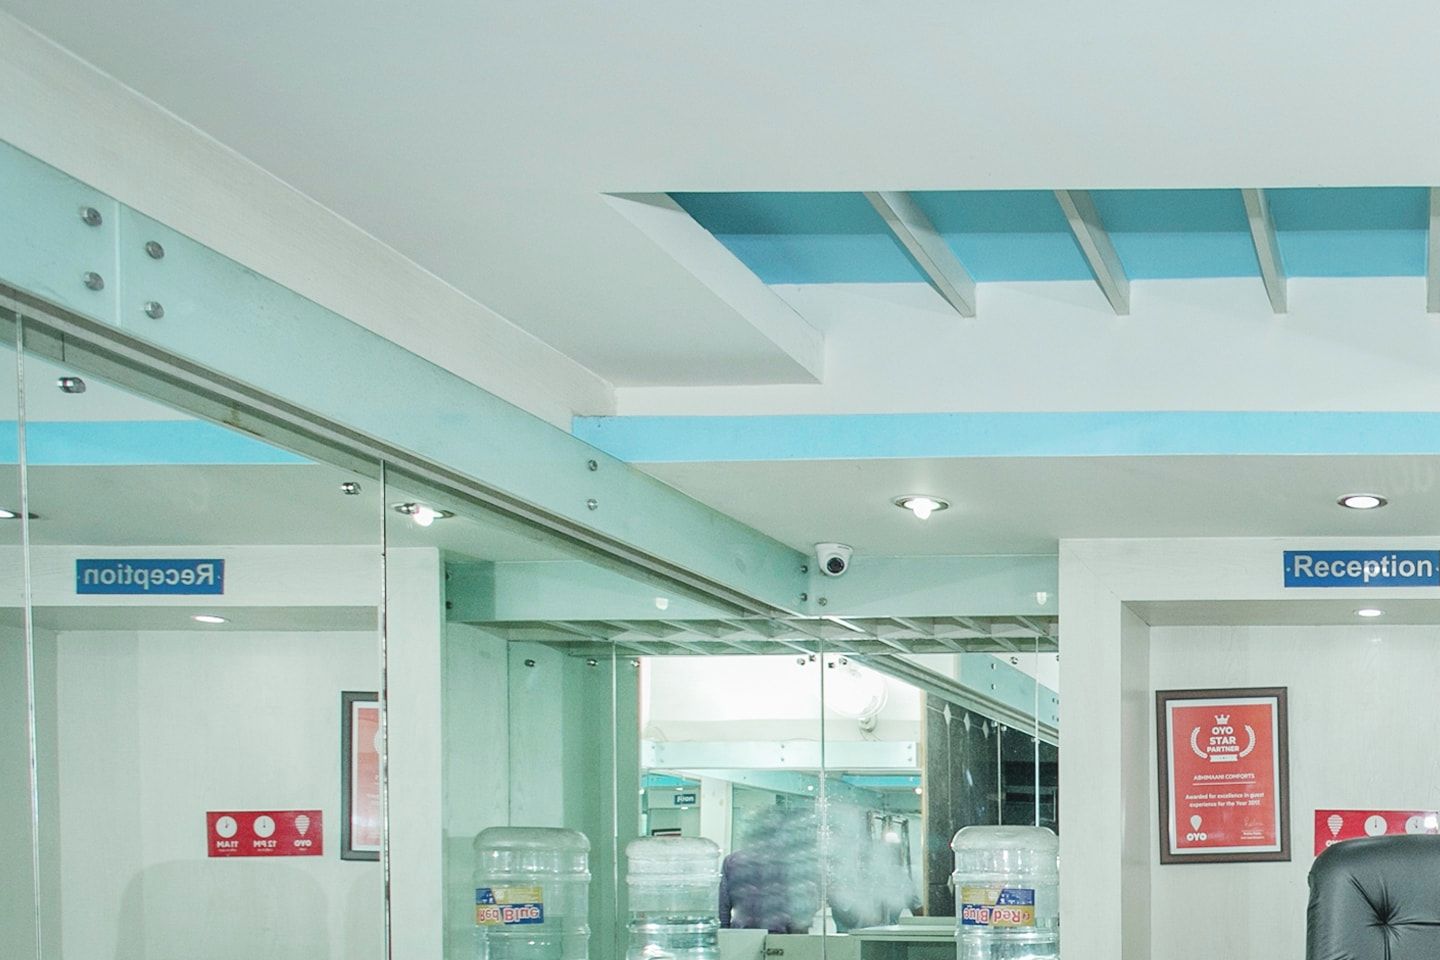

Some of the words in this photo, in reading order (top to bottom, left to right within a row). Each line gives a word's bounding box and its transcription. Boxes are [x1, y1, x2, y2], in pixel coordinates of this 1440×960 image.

[1294, 554, 1433, 583] Reception
[1211, 726, 1234, 736] OYO
[1209, 736, 1237, 746] STAR
[1206, 745, 1240, 753] PARTNER
[1186, 832, 1208, 842] OYO
[963, 907, 989, 923] Blue
[992, 908, 1022, 924] Red
